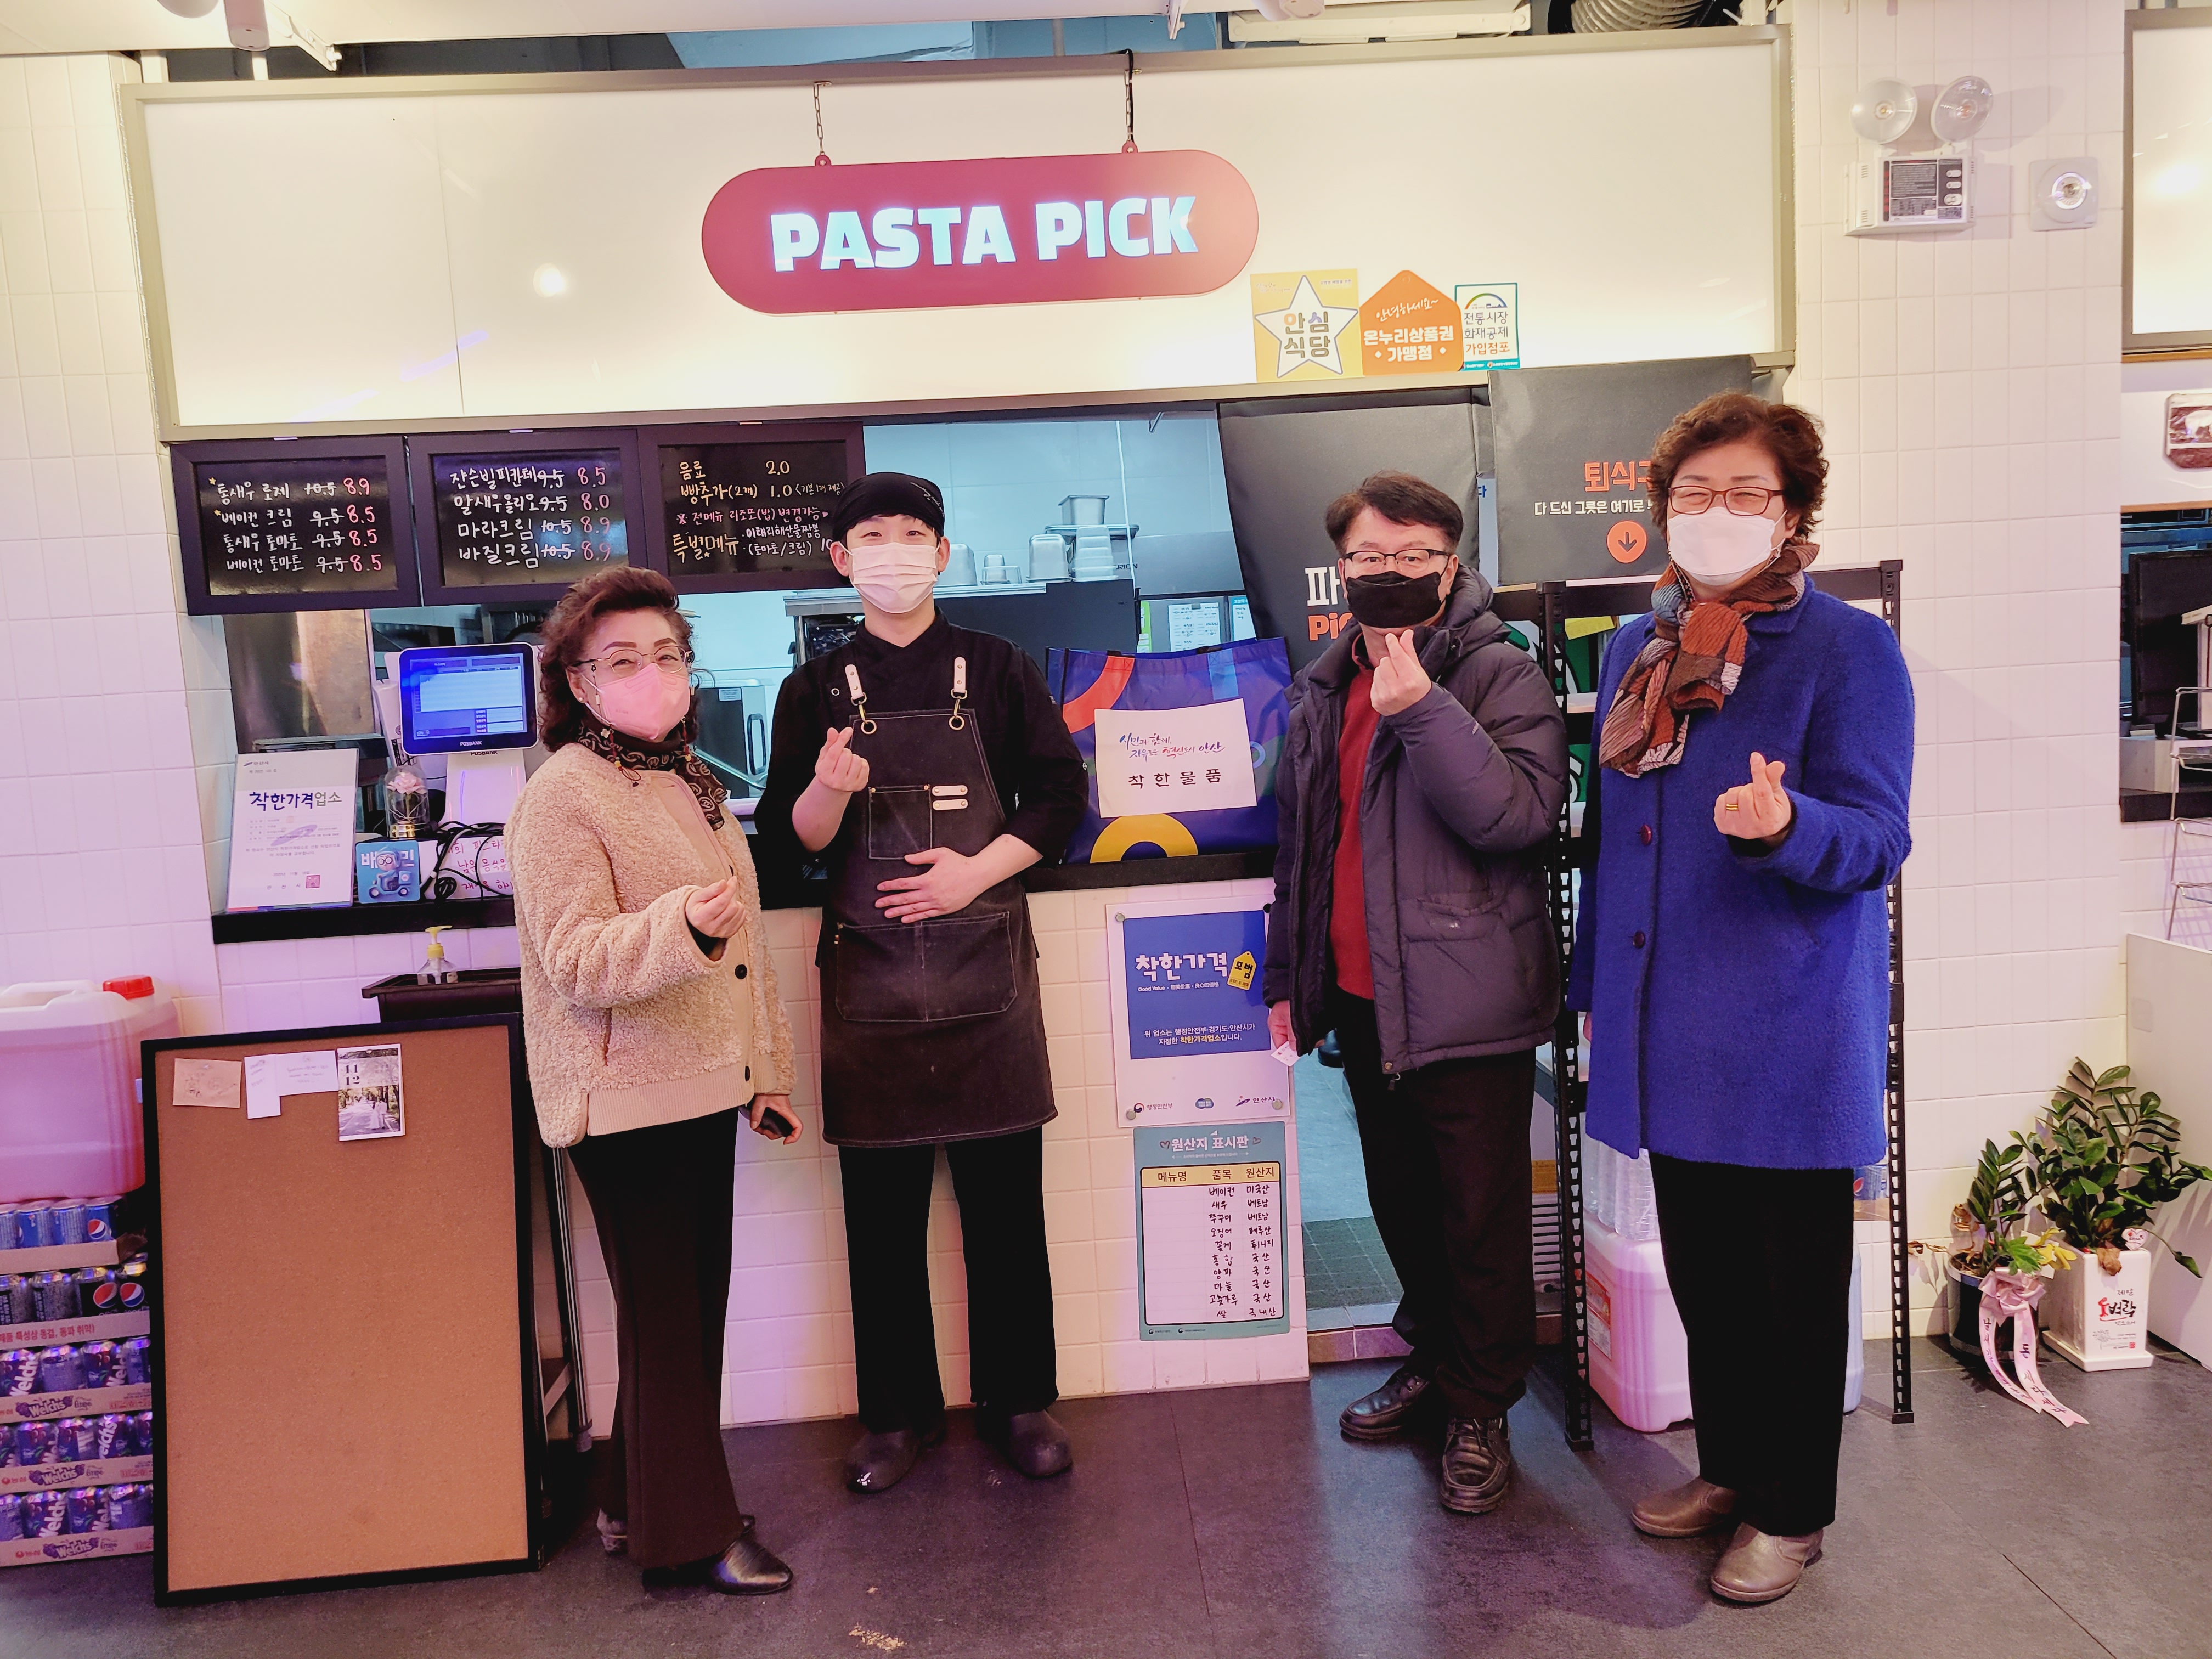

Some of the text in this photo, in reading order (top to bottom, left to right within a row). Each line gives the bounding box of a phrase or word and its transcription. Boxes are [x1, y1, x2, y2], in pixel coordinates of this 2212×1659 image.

[770, 196, 1199, 273] PASTA PICK
[1284, 311, 1329, 334] 안심
[1464, 312, 1508, 325] 전통시장
[1364, 325, 1454, 346] 온누리상품권
[1464, 326, 1508, 340] 화재공제
[1284, 336, 1330, 358] 식당
[1387, 345, 1432, 362] 가맹점
[1465, 342, 1510, 356] 가입점포
[578, 467, 606, 488] 8.5
[679, 460, 790, 481] 음료 2.0
[218, 481, 255, 505] 통새우
[261, 483, 290, 501] 로제
[343, 478, 370, 495] 8.9
[771, 485, 792, 498] 1.0
[581, 493, 610, 511] 8.0
[1534, 501, 1547, 515] 다
[1550, 501, 1571, 514] 드신
[1575, 500, 1607, 514] 그릇은
[1611, 500, 1644, 513] 여기로
[221, 512, 258, 527] 베이컨
[267, 508, 292, 527] 크림
[347, 505, 375, 524] 8.5
[692, 511, 724, 526] 전메뉴
[778, 507, 820, 523] 변경가능
[458, 518, 533, 540] 마라크림
[580, 516, 610, 535] 8.9
[223, 533, 259, 553] 통새우
[266, 533, 303, 551] 토마토
[349, 529, 377, 547] 8.5
[673, 533, 739, 563] 특별메뉴
[227, 558, 263, 573] 베이컨
[269, 555, 304, 572] 토마토
[350, 554, 382, 572] 8.5
[459, 543, 539, 569] 바질크림
[581, 541, 611, 561] 8.9
[1199, 741, 1226, 754] 안산
[249, 792, 342, 811] 착한가격업소
[1136, 952, 1227, 981] 착한가격
[1234, 961, 1253, 979] 모범
[1171, 1135, 1249, 1152] 원산지 표시판
[1158, 1167, 1274, 1182] 메뉴명 품목 원산지
[1209, 1185, 1270, 1197] 베이컨 미국산
[1212, 1199, 1268, 1210] 새우 베트남
[1211, 1228, 1232, 1238] 오징어
[1217, 1310, 1227, 1318] 쌀
